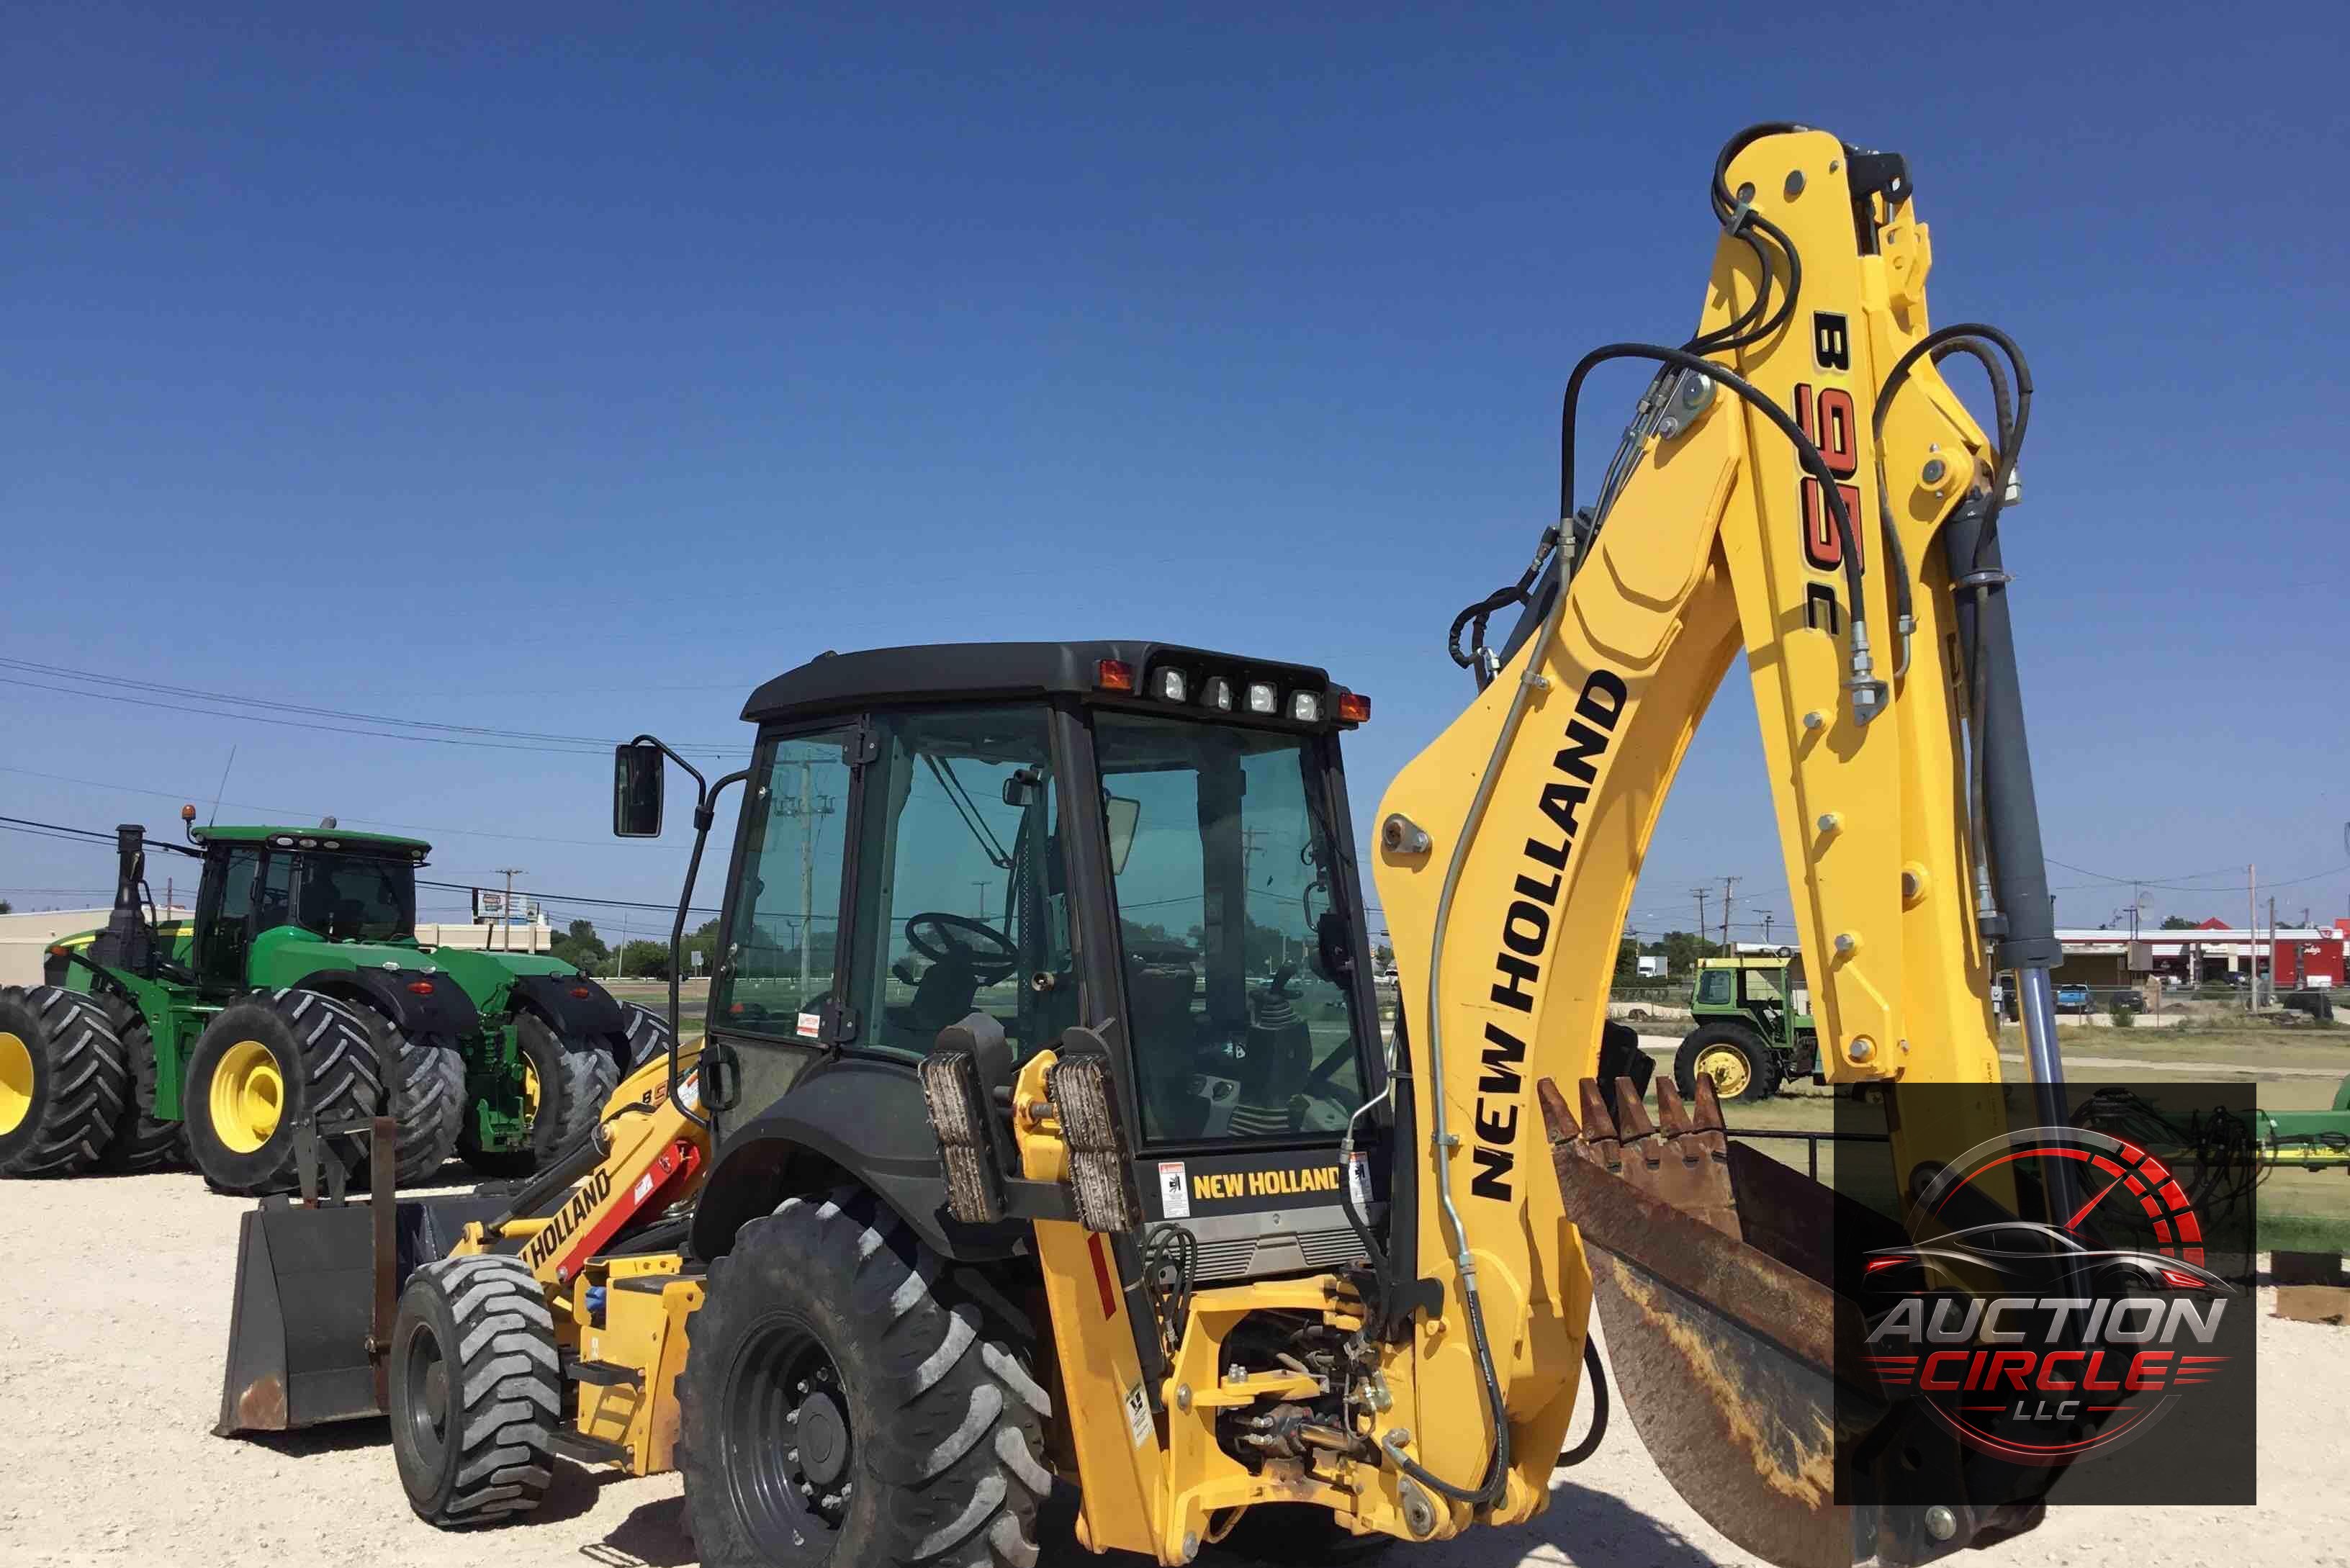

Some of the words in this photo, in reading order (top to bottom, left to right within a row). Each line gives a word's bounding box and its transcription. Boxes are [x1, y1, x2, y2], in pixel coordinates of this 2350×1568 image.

[1490, 668, 1629, 1014] HOLLAND
[1193, 1173, 1244, 1199] NEW
[1248, 1166, 1340, 1196] HOLLAND
[1472, 1022, 1527, 1203] NEW
[531, 1168, 611, 1270] HOLLAND
